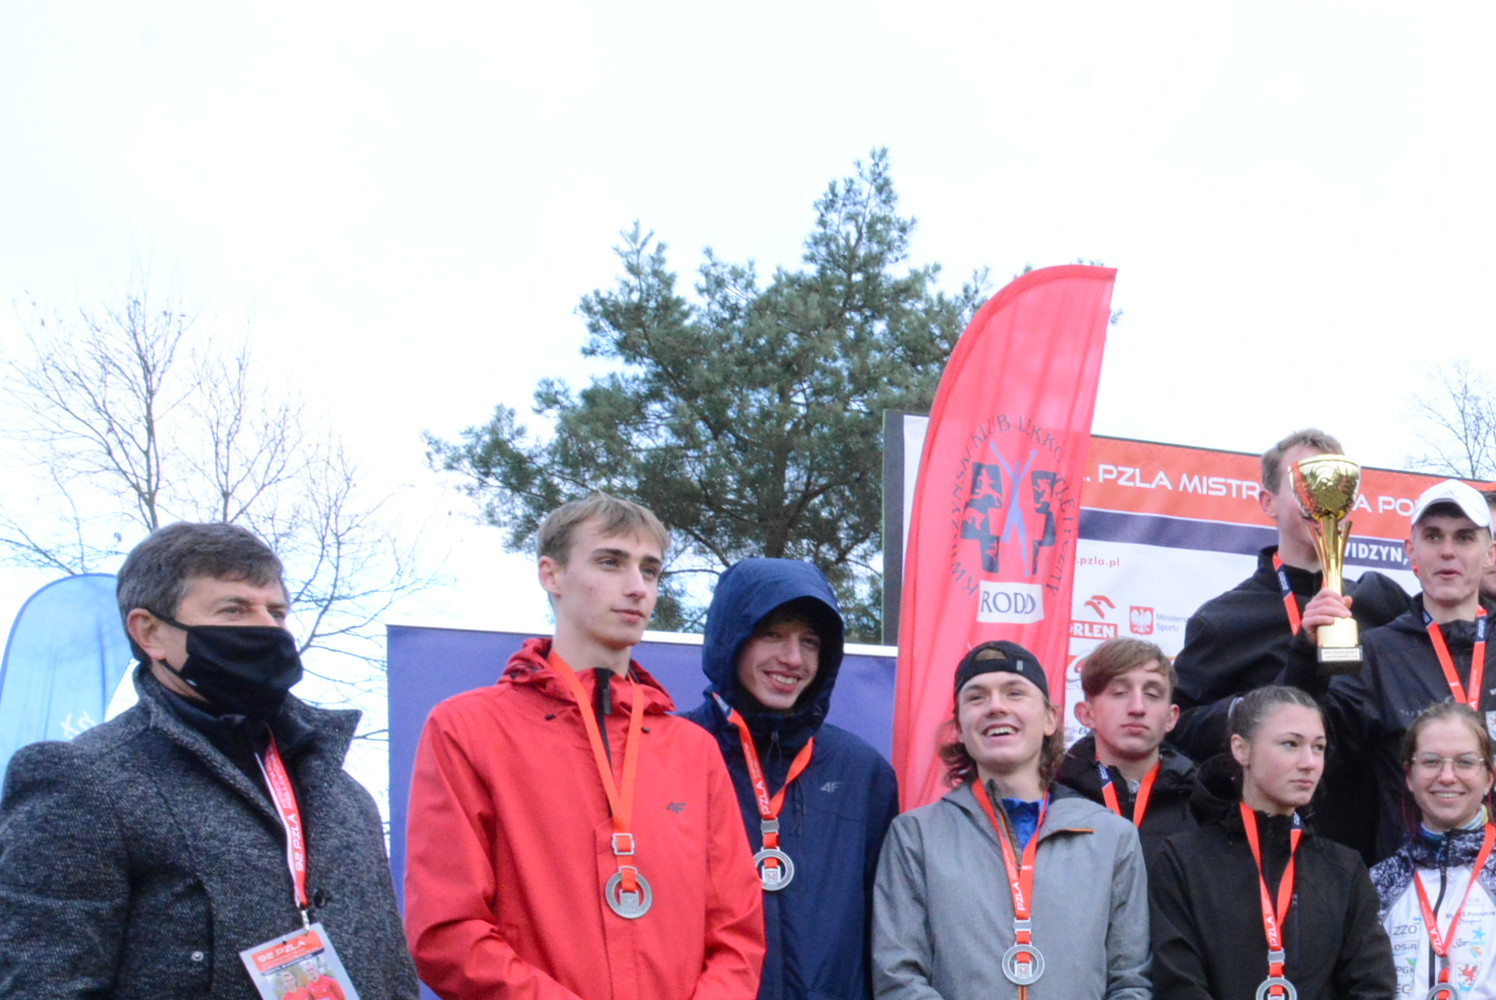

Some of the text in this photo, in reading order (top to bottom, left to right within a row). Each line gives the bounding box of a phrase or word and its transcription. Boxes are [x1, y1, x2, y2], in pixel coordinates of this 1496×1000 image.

[1098, 464, 1174, 491] PZLA
[1378, 495, 1417, 517] PO
[755, 780, 772, 815] PZLA
[821, 781, 846, 793] 4F
[666, 801, 687, 814] 4F
[286, 813, 303, 850] PZLA
[1012, 881, 1026, 911] PZLA
[1266, 915, 1279, 947] PZLA
[1392, 925, 1418, 936] ZZO
[257, 952, 275, 963] 92
[275, 940, 307, 956] PZLA
[1396, 965, 1415, 975] PGK
[1396, 983, 1410, 995] EC
